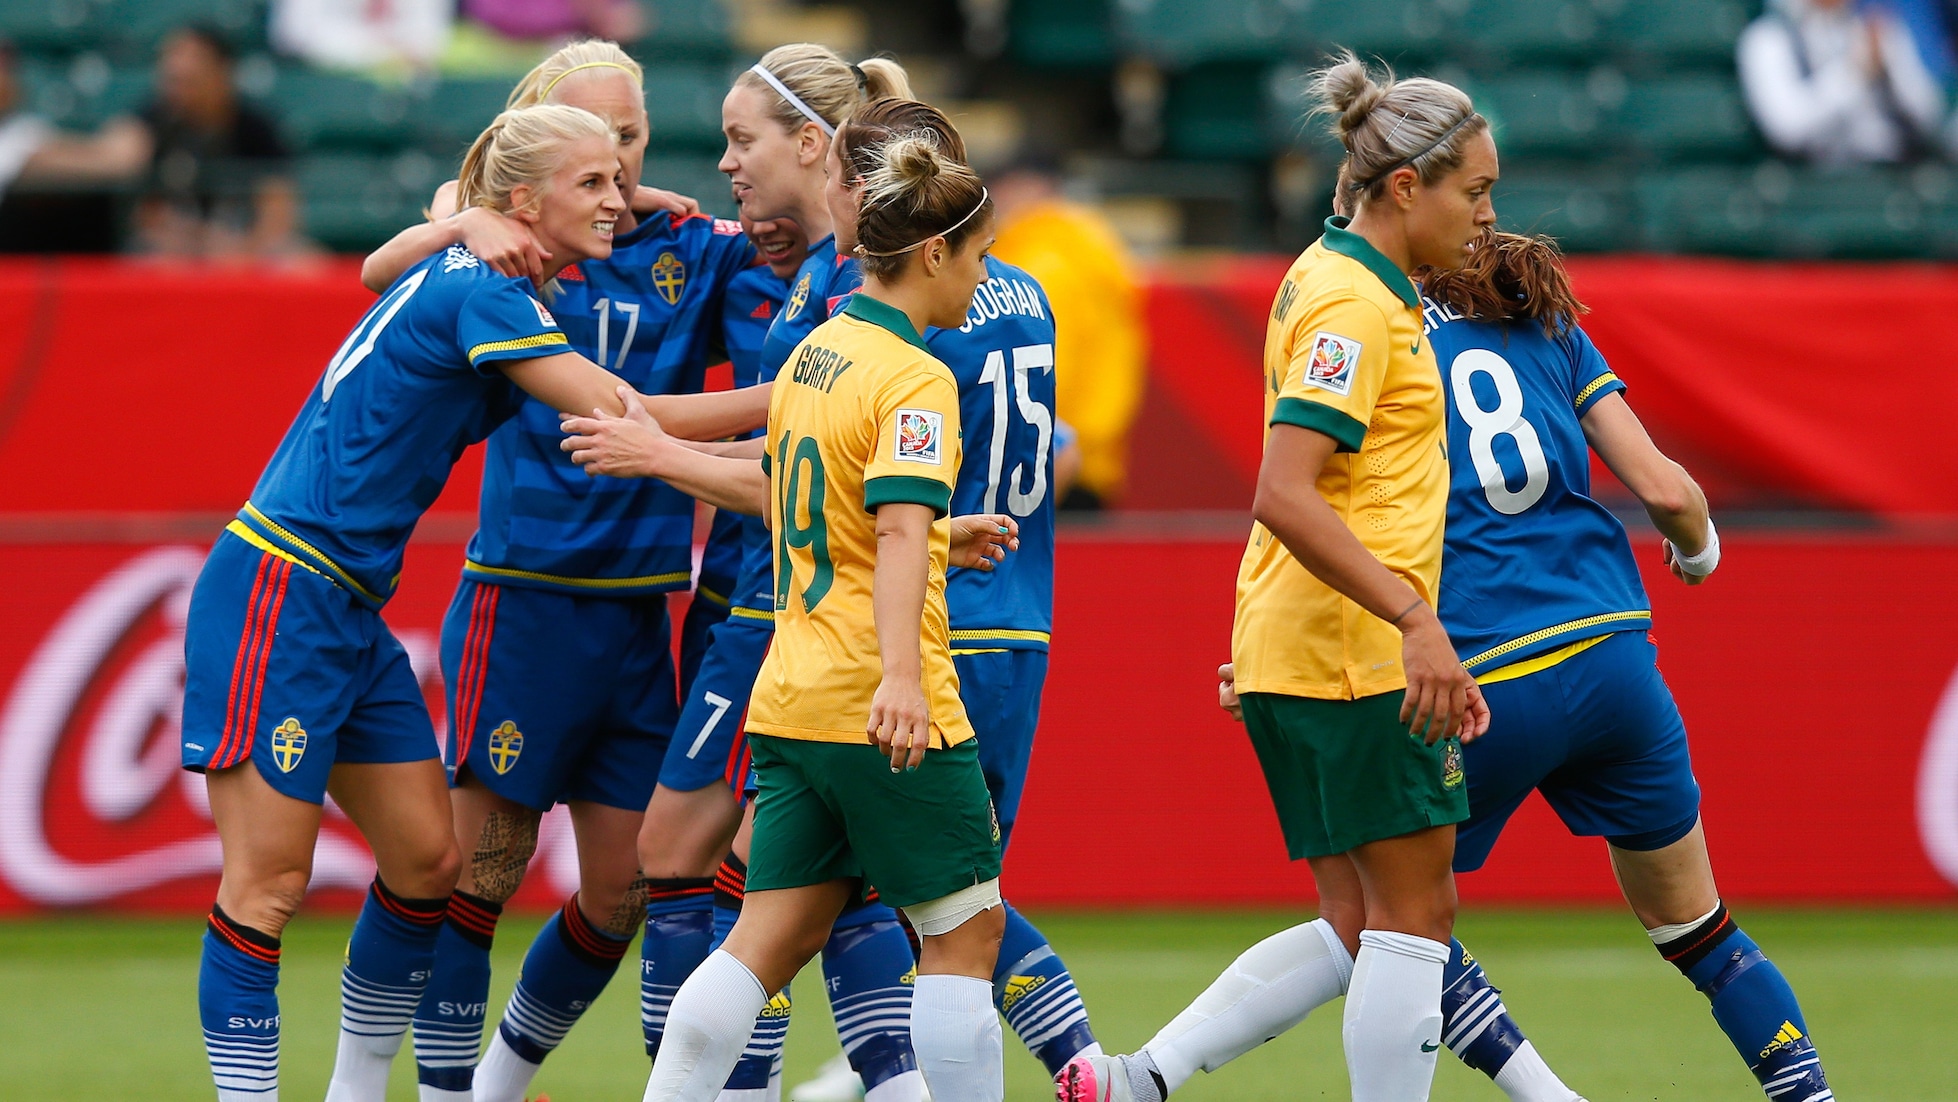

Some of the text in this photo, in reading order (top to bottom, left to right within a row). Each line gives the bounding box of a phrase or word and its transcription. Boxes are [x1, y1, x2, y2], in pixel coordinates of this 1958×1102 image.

[592, 297, 640, 370] 17
[792, 343, 854, 395] GORRY
[977, 343, 1054, 518] 15
[1450, 348, 1550, 516] 8
[776, 429, 835, 615] 19
[685, 690, 733, 760] 7
